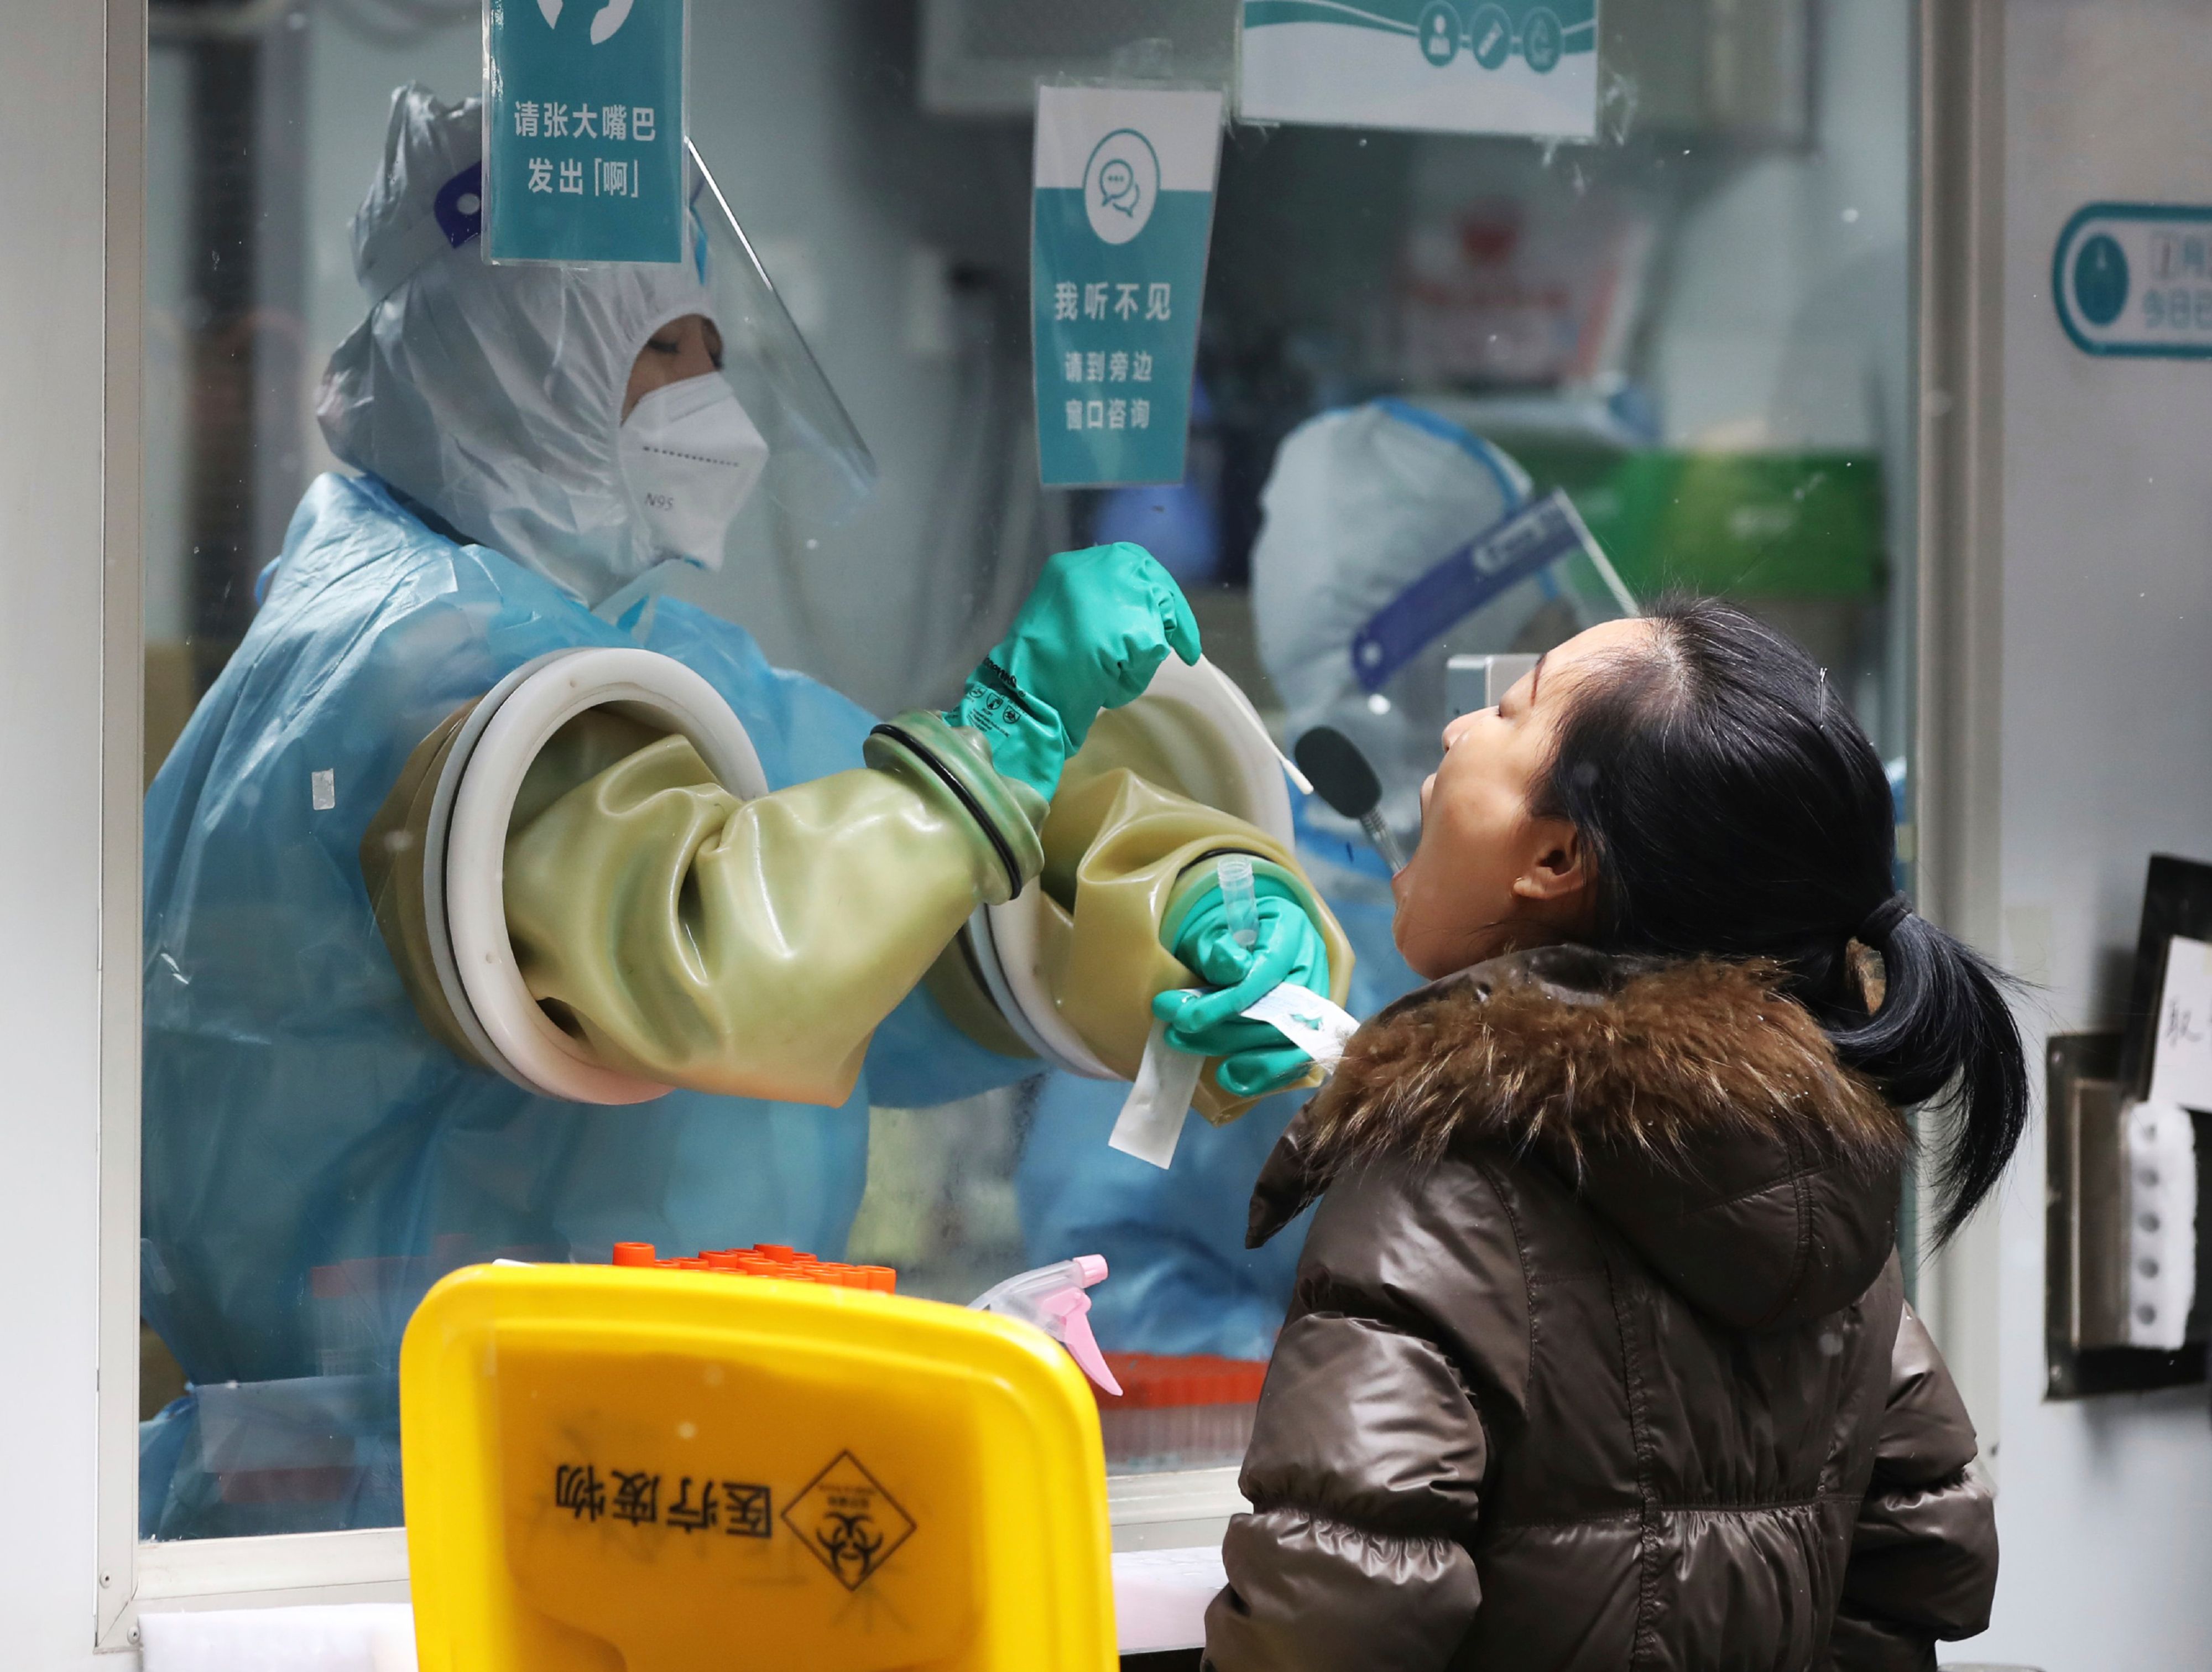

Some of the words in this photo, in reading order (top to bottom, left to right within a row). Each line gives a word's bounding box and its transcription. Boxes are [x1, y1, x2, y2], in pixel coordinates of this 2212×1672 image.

[514, 101, 656, 142] 请张大嘴巴
[1055, 282, 1172, 321] 我听不见
[1065, 351, 1153, 382] 请到旁边
[1065, 398, 1151, 430] 窗口咨询
[644, 492, 674, 511] N95
[556, 1465, 773, 1539] 医疗废物
